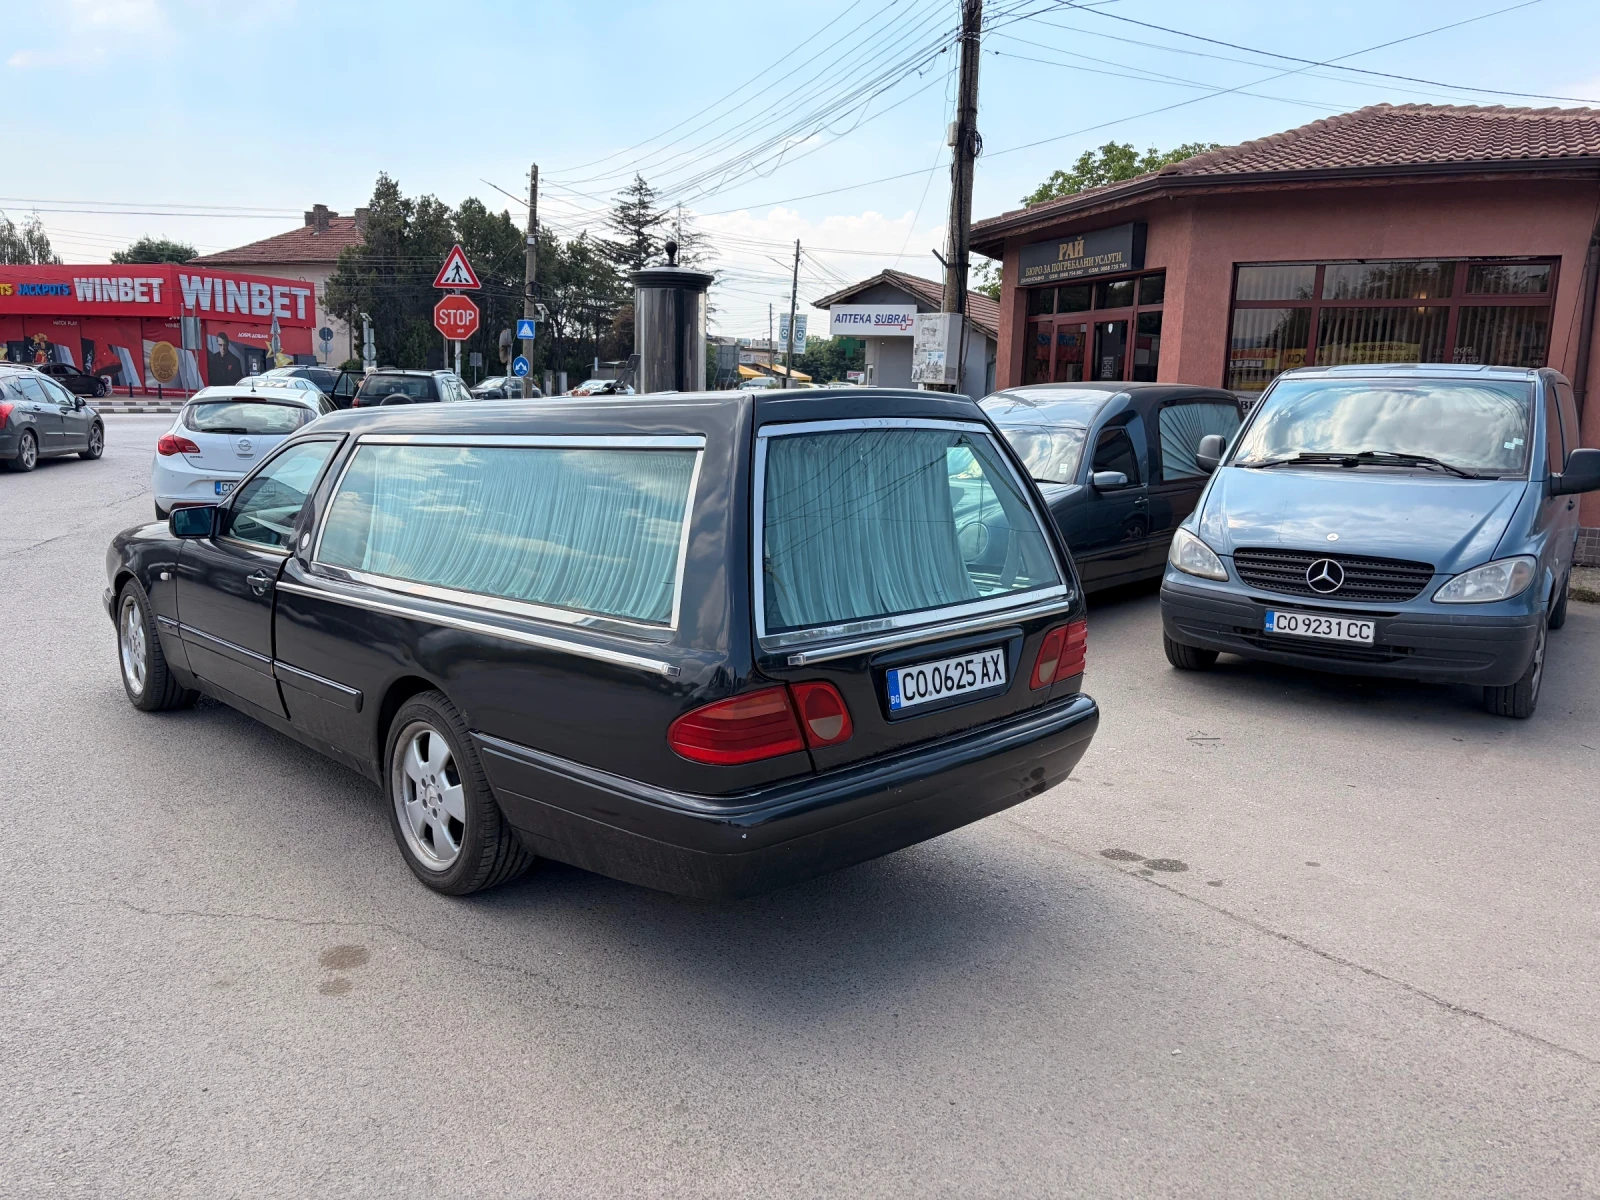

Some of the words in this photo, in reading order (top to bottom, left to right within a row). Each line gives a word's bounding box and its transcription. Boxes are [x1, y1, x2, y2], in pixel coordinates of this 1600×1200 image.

[1058, 235, 1084, 260] РАЙ
[1025, 265, 1043, 277] БЮРО
[1043, 264, 1051, 274] ЗА
[1051, 256, 1094, 272] ПОГРЕБАЛНИ
[1095, 251, 1122, 265] УСЛУГИ
[17, 283, 71, 296] JACKPOTS
[73, 277, 164, 303] WINBET
[179, 273, 311, 320] WINBET
[439, 309, 475, 326] STOP
[834, 313, 872, 324] АПТЕКА
[874, 313, 907, 324] SUBRA
[1276, 614, 1299, 632] CO
[1302, 617, 1342, 637] 9231
[1346, 622, 1371, 640] CC
[890, 694, 900, 705] BG
[931, 659, 977, 695] 0625
[980, 653, 1003, 685] AX
